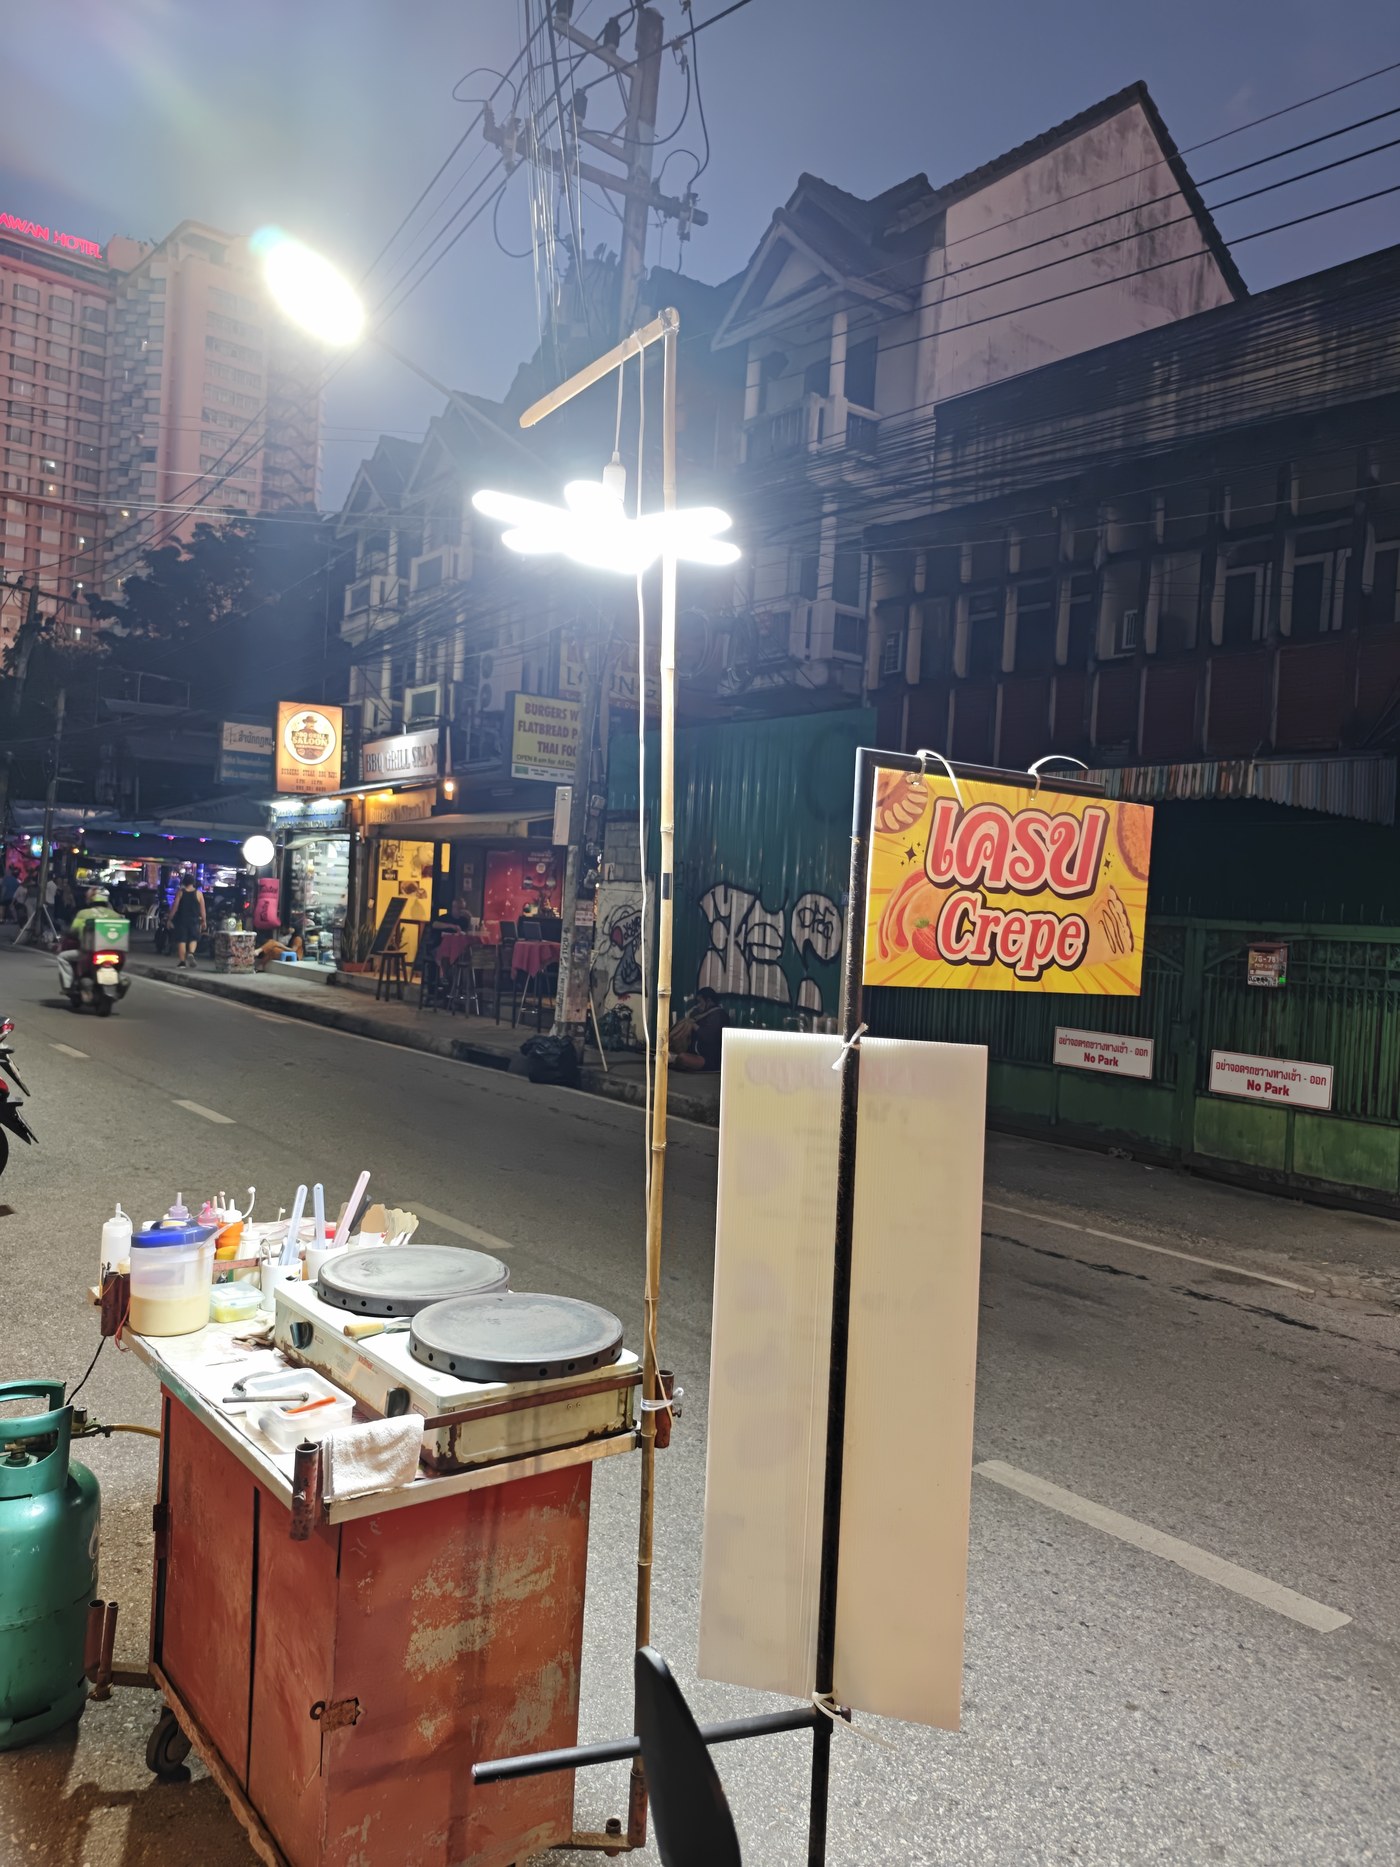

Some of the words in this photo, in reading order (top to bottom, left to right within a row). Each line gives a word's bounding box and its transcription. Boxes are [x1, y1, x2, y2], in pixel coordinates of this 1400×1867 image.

[0, 212, 50, 241] AWAN
[53, 231, 103, 259] HOTEL
[524, 702, 567, 720] BURGERS
[518, 720, 570, 738] FLATBREAD
[292, 737, 328, 747] SALOON
[537, 741, 559, 755] THAI
[365, 752, 384, 774] BBQ
[386, 749, 411, 772] GRILL
[927, 797, 1108, 898] เครป
[939, 891, 1088, 979] Crepe
[1083, 1052, 1096, 1063] No
[1098, 1054, 1119, 1067] Park
[1134, 1047, 1149, 1057] ออก
[1215, 1059, 1301, 1082] อย่าจอดรถขวางทางเข้า
[1309, 1075, 1327, 1086] ออก
[1246, 1079, 1261, 1091] No
[1264, 1082, 1290, 1096] Park
